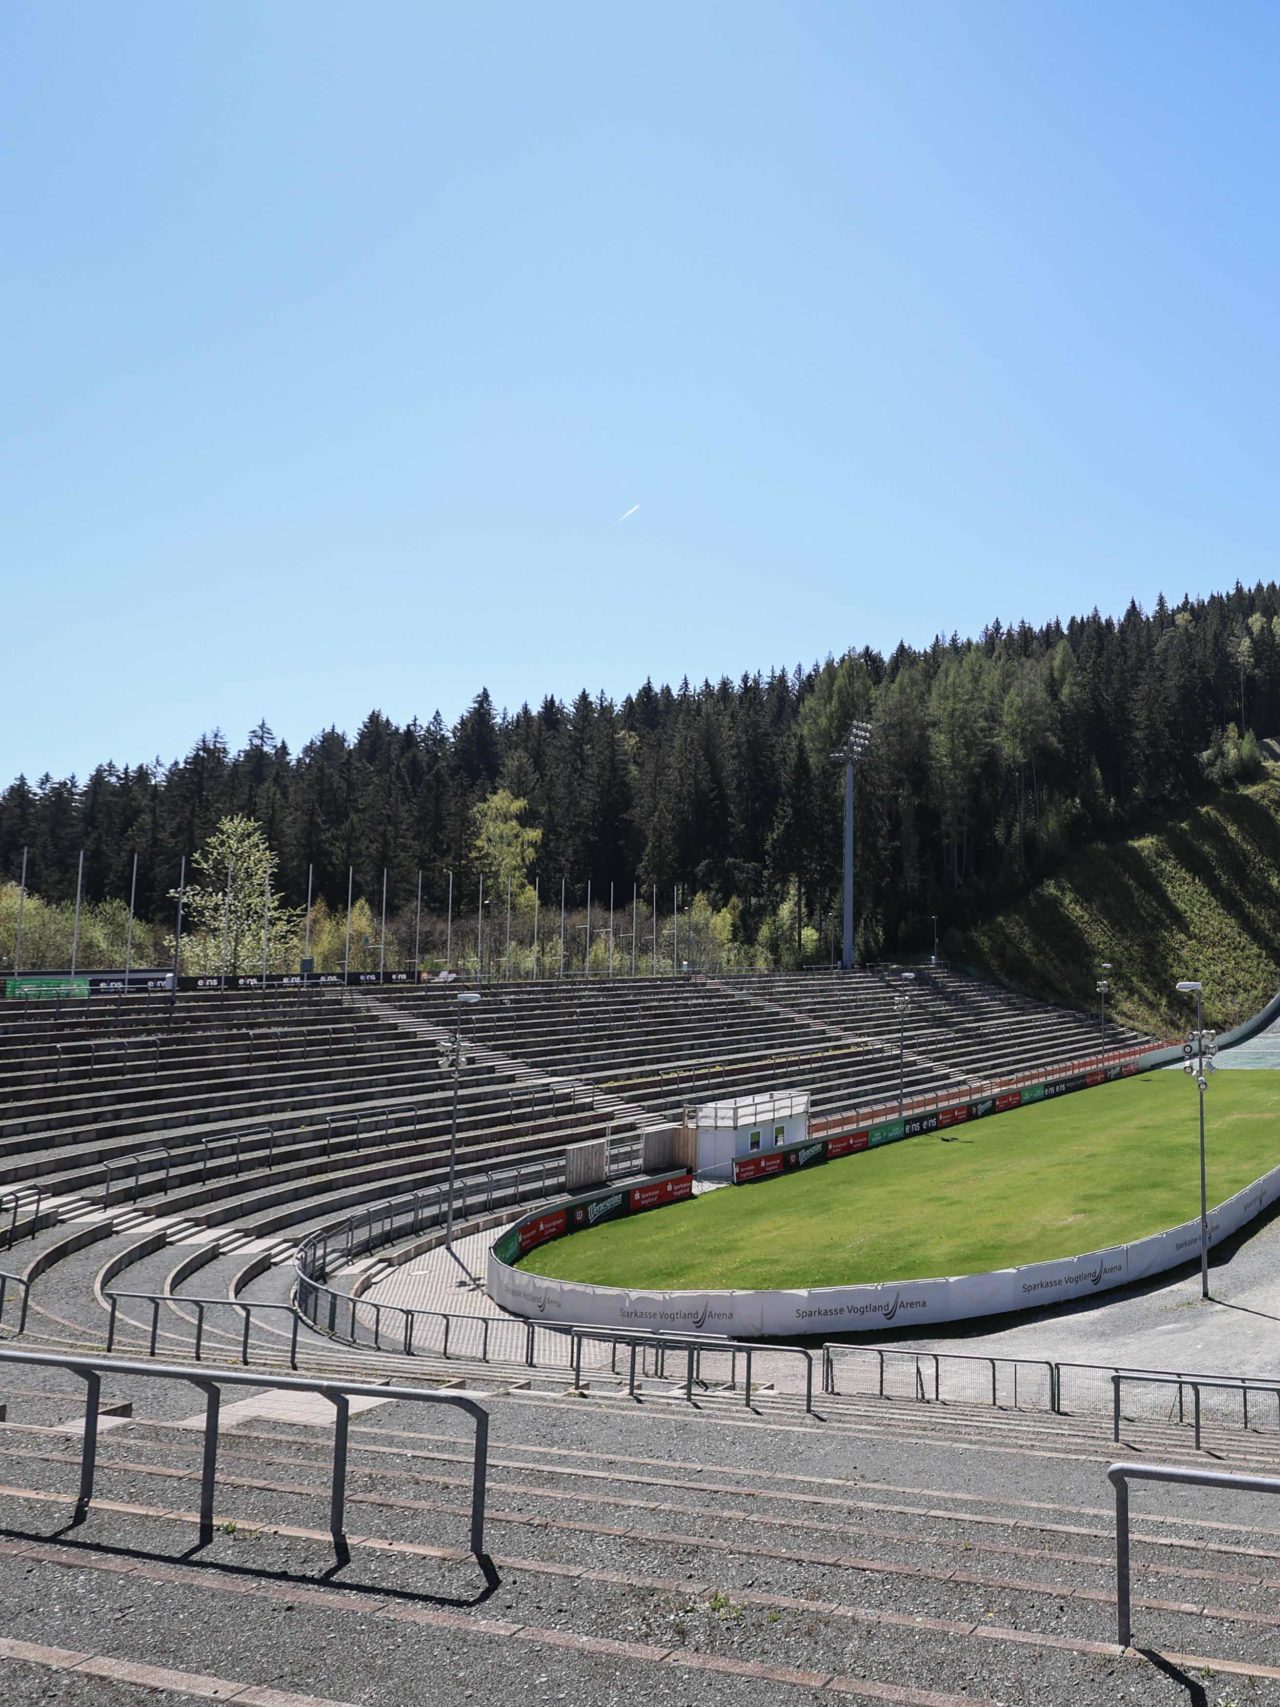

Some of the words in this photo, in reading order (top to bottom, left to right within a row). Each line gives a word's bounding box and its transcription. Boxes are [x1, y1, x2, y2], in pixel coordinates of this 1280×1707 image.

[198, 977, 218, 986] eins
[905, 1121, 921, 1134] eins
[922, 1116, 937, 1130] eins
[1022, 1279, 1063, 1294] Sparkasse
[1064, 1270, 1097, 1286] Vogtland
[1102, 1264, 1122, 1275] Arena
[658, 1310, 699, 1321] Vogtland
[707, 1310, 733, 1320] Arena
[795, 1307, 845, 1319] Sparkasse
[847, 1302, 890, 1316] Vogtland
[898, 1300, 927, 1309] Arena
